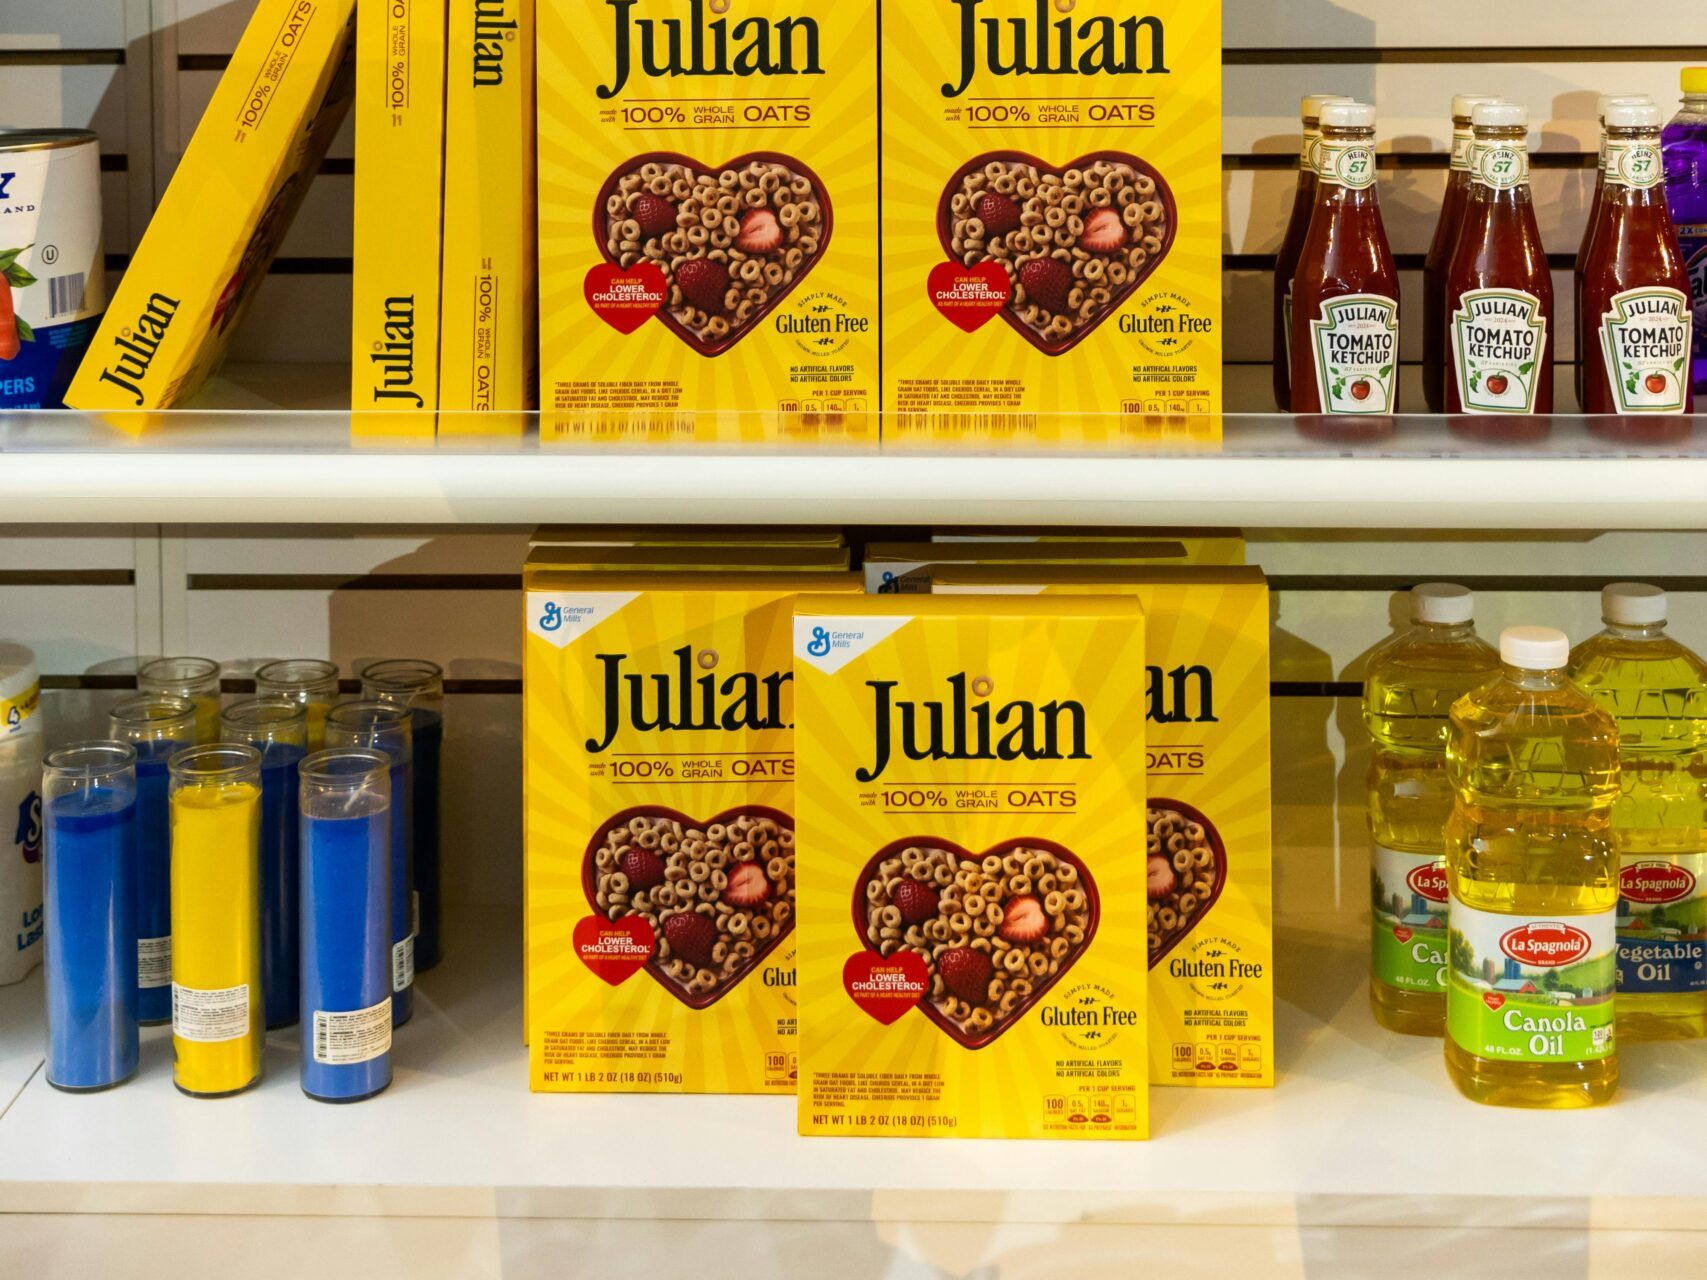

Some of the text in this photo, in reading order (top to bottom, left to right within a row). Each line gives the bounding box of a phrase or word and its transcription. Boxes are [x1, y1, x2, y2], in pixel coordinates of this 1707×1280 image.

[242, 0, 311, 128] 100% WHOLE GRAIN OATS
[392, 62, 404, 109] 100%
[620, 107, 686, 123] 100%
[693, 115, 735, 123] GRAIN
[743, 105, 810, 122] OATS
[965, 106, 1030, 122] 100%
[1038, 114, 1080, 122] GRAIN
[1088, 104, 1155, 121] OATS
[1348, 151, 1368, 160] HEINZ
[1349, 161, 1367, 173] 57
[1492, 161, 1512, 173] 57
[1632, 160, 1651, 172] 57
[610, 285, 645, 293] LOWER
[953, 283, 988, 291] LOWER
[479, 274, 492, 322] 100%
[1338, 307, 1387, 324] JULIAN
[1475, 301, 1529, 320] JULIAN
[1628, 300, 1678, 317] JULIAN
[775, 313, 869, 333] Gluten Free
[1118, 314, 1212, 333] Gluten Free
[1327, 333, 1392, 350] TOMATO
[1466, 325, 1534, 346] TOMATO
[1619, 326, 1683, 344] TOMATO
[99, 291, 180, 406] Julian
[370, 293, 424, 409] Julian
[1331, 350, 1390, 364] KETCHUP
[1469, 343, 1531, 360] KETCHUP
[1623, 344, 1681, 358] KETCHUP
[562, 607, 594, 615] General
[832, 631, 864, 640] General
[832, 640, 851, 648] Mills
[855, 670, 1091, 783] Julian
[609, 760, 794, 778] 100% WHOLE GRAIN OATS
[881, 790, 1076, 808] 100% WHOLE GRAIN OATS
[1621, 877, 1685, 892] La Spagnola
[598, 937, 633, 945] LOWER
[1511, 938, 1580, 955] La Spagnola
[1169, 958, 1263, 978] Gluten Free
[1637, 963, 1671, 981] Oil
[762, 967, 796, 987] Glut
[869, 973, 905, 981] LOWER
[1063, 984, 1116, 1000] SIMPLY MADE
[1041, 1006, 1137, 1026] Gluten Free
[1504, 1010, 1587, 1032] Canola
[1529, 1034, 1563, 1056] Oil
[1047, 1098, 1064, 1109] 100
[813, 1115, 828, 1124] NET
[832, 1115, 844, 1124] WT
[856, 1115, 867, 1125] LB
[870, 1115, 875, 1125] 2
[878, 1115, 889, 1125] OZ
[893, 1115, 907, 1126] (18
[910, 1116, 925, 1127] OZ)
[928, 1116, 957, 1127] (510g)
